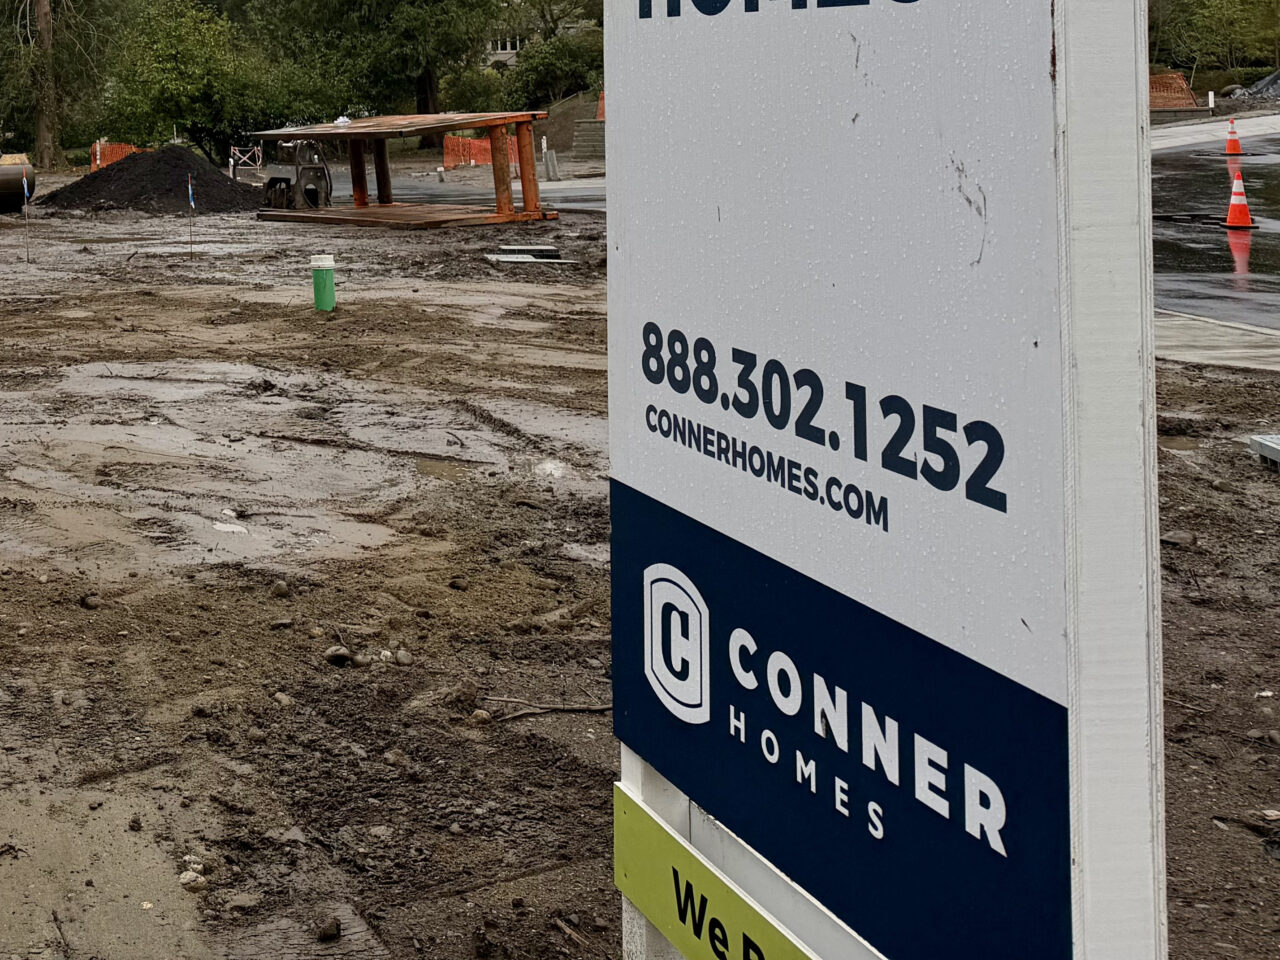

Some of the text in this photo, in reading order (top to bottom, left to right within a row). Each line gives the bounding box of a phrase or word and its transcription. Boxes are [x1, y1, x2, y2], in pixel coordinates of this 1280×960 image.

[641, 321, 1007, 514] 888.302.1252
[645, 404, 888, 532] CONNERHOMES.COM
[729, 628, 1008, 858] CONNER
[729, 704, 885, 840] HOMES
[671, 865, 730, 960] We
